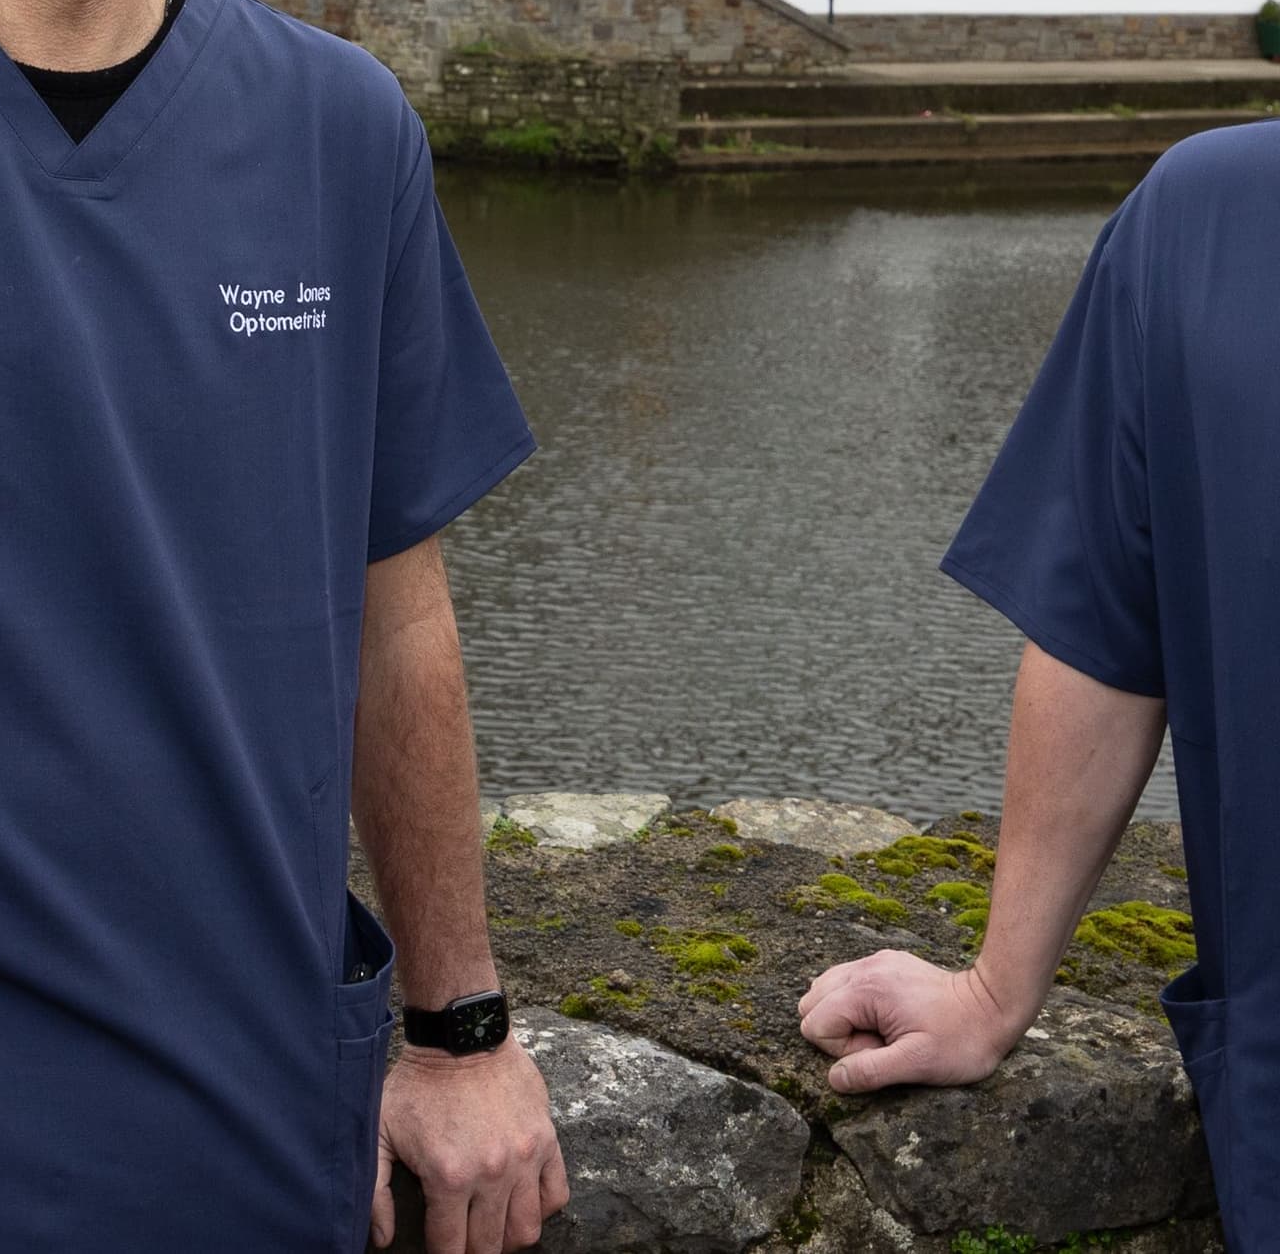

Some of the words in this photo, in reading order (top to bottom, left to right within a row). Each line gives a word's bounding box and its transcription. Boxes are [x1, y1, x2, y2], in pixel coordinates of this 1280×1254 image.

[219, 284, 285, 310] Wayne
[297, 282, 331, 303] Jones
[230, 308, 327, 337] Optometrist
